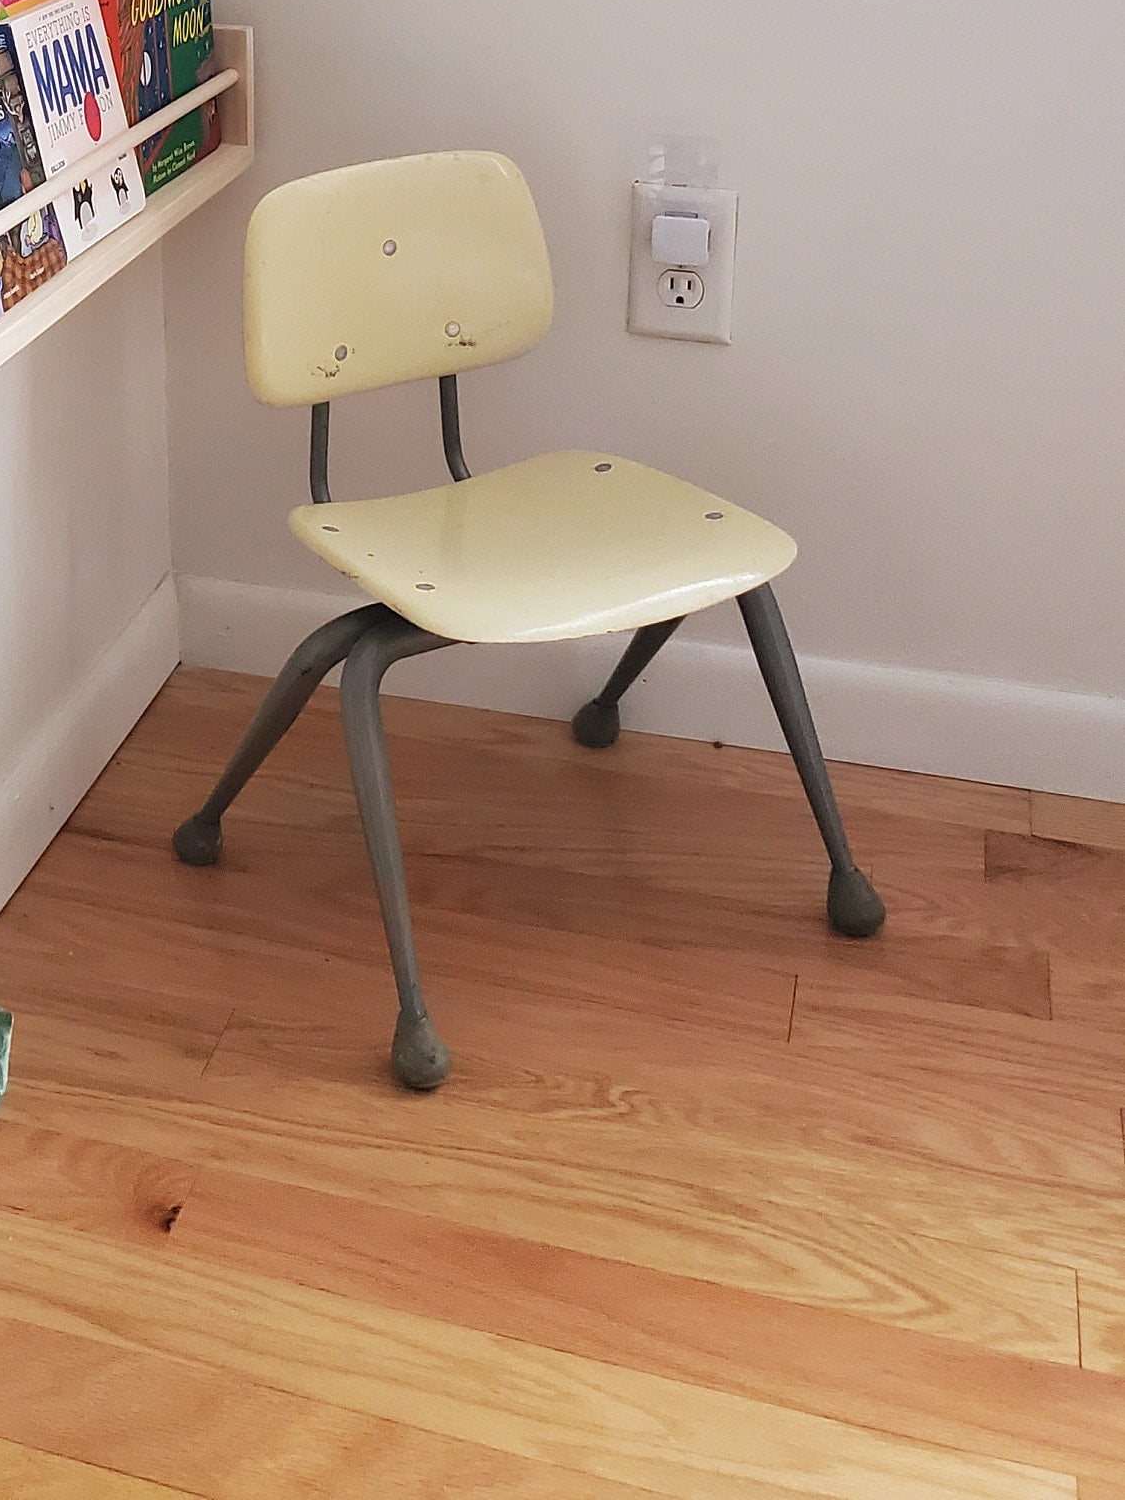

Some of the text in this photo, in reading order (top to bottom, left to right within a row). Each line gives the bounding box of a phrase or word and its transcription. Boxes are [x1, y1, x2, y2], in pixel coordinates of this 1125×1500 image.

[25, 5, 91, 49] EVERYTHING IS
[173, 3, 204, 48] MOON
[29, 23, 110, 125] MAMA
[47, 112, 77, 148] JIMMY
